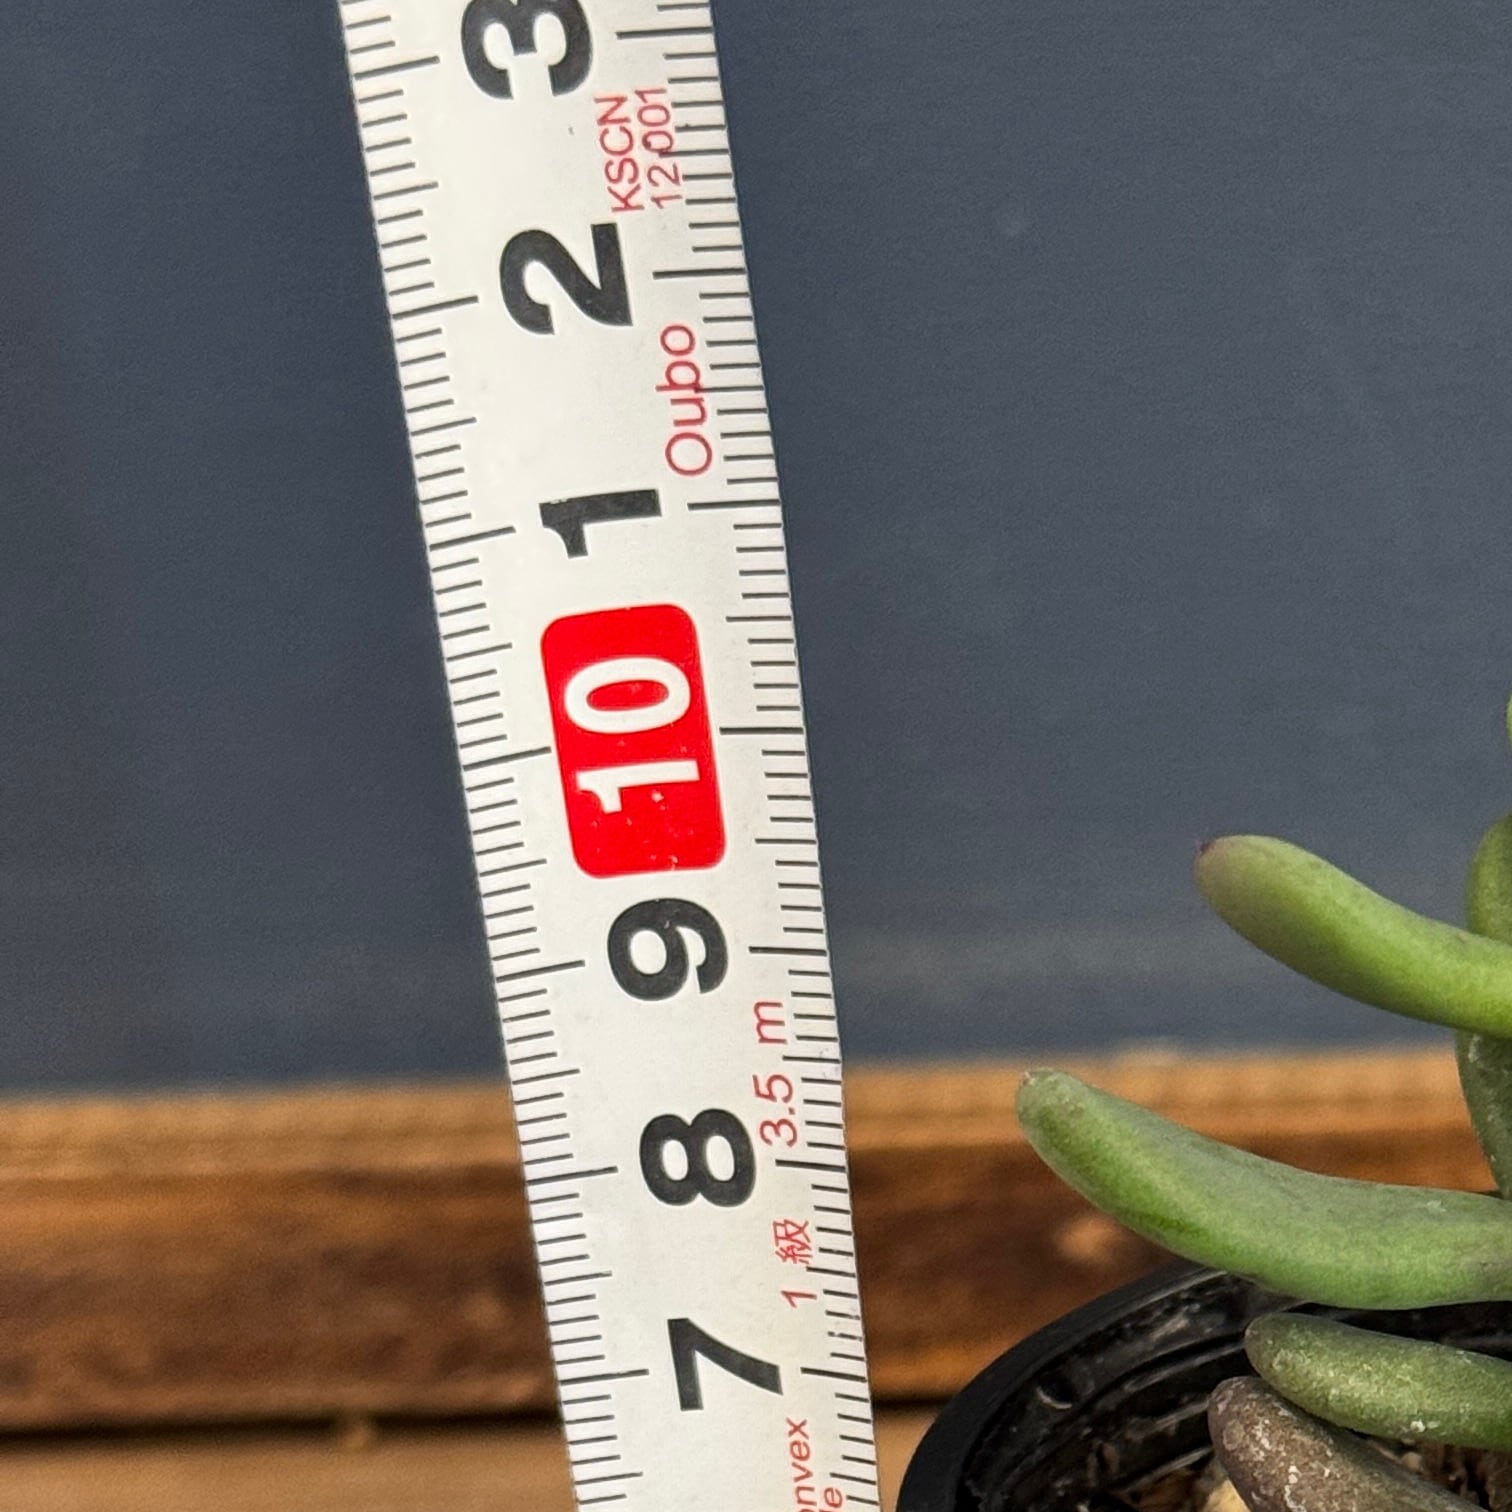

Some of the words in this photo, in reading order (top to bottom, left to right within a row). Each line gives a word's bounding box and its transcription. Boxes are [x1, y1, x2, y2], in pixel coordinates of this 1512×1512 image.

[461, 0, 593, 99] 3
[594, 96, 645, 213] KSCN
[500, 223, 633, 335] 2
[655, 324, 713, 476] Oubo
[539, 488, 662, 558] 1
[564, 656, 700, 814] 10
[607, 898, 728, 1001] 9
[753, 1001, 788, 1045] m
[639, 1109, 756, 1207] 8
[753, 1074, 798, 1147] 3.5
[667, 1317, 784, 1412] 7
